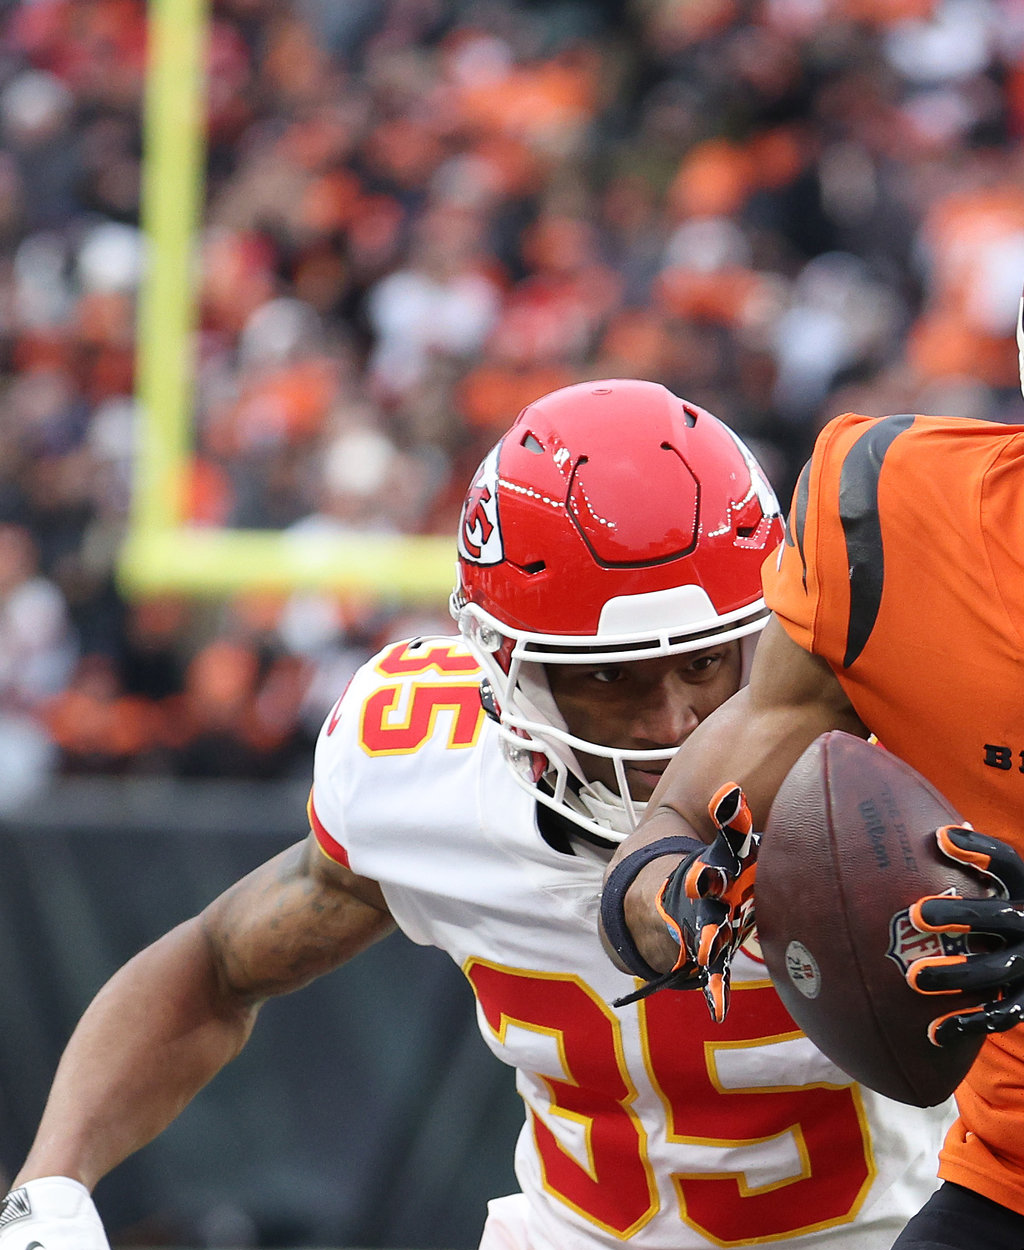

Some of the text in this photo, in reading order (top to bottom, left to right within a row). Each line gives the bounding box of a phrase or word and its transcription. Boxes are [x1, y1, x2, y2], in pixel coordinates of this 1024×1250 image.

[358, 643, 486, 758] 35
[857, 799, 891, 870] Wilson
[462, 955, 877, 1249] 35
